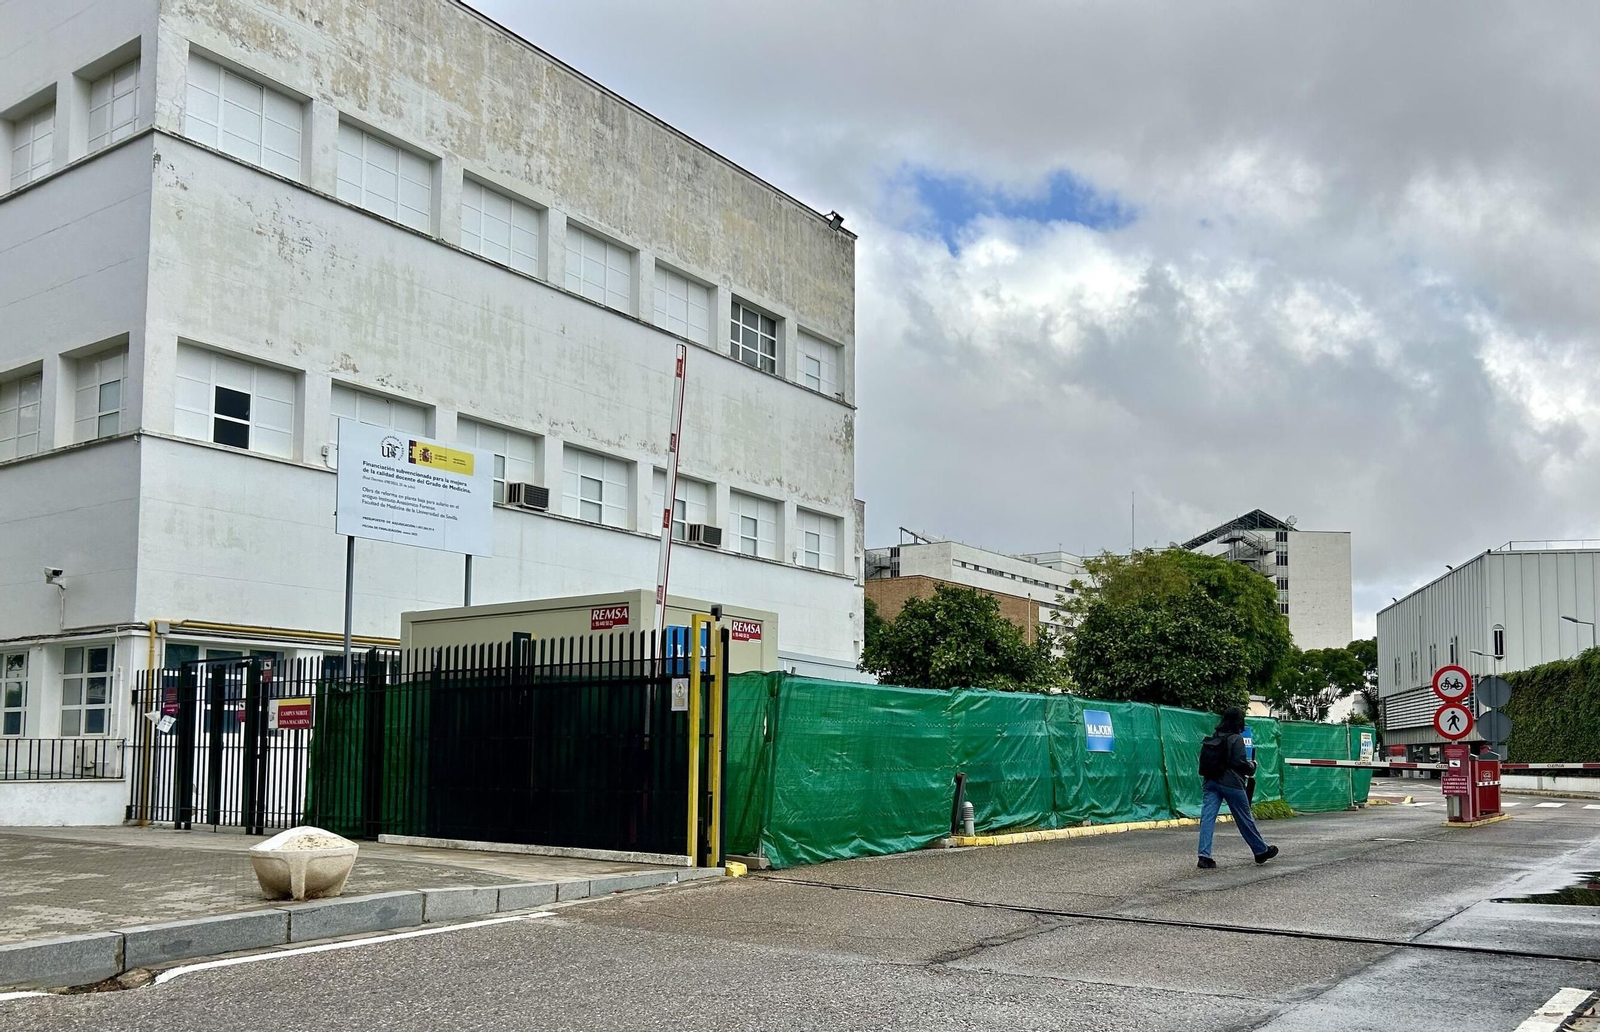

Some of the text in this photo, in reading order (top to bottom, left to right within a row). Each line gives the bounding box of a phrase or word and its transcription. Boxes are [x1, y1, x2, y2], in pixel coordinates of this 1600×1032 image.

[363, 460, 394, 472] Financiación
[396, 469, 431, 480] subvencionada
[396, 474, 415, 482] docente
[449, 485, 471, 494] Medicina.
[416, 509, 438, 517] Universidad
[592, 608, 628, 620] REMSA
[733, 621, 760, 634] REMSA
